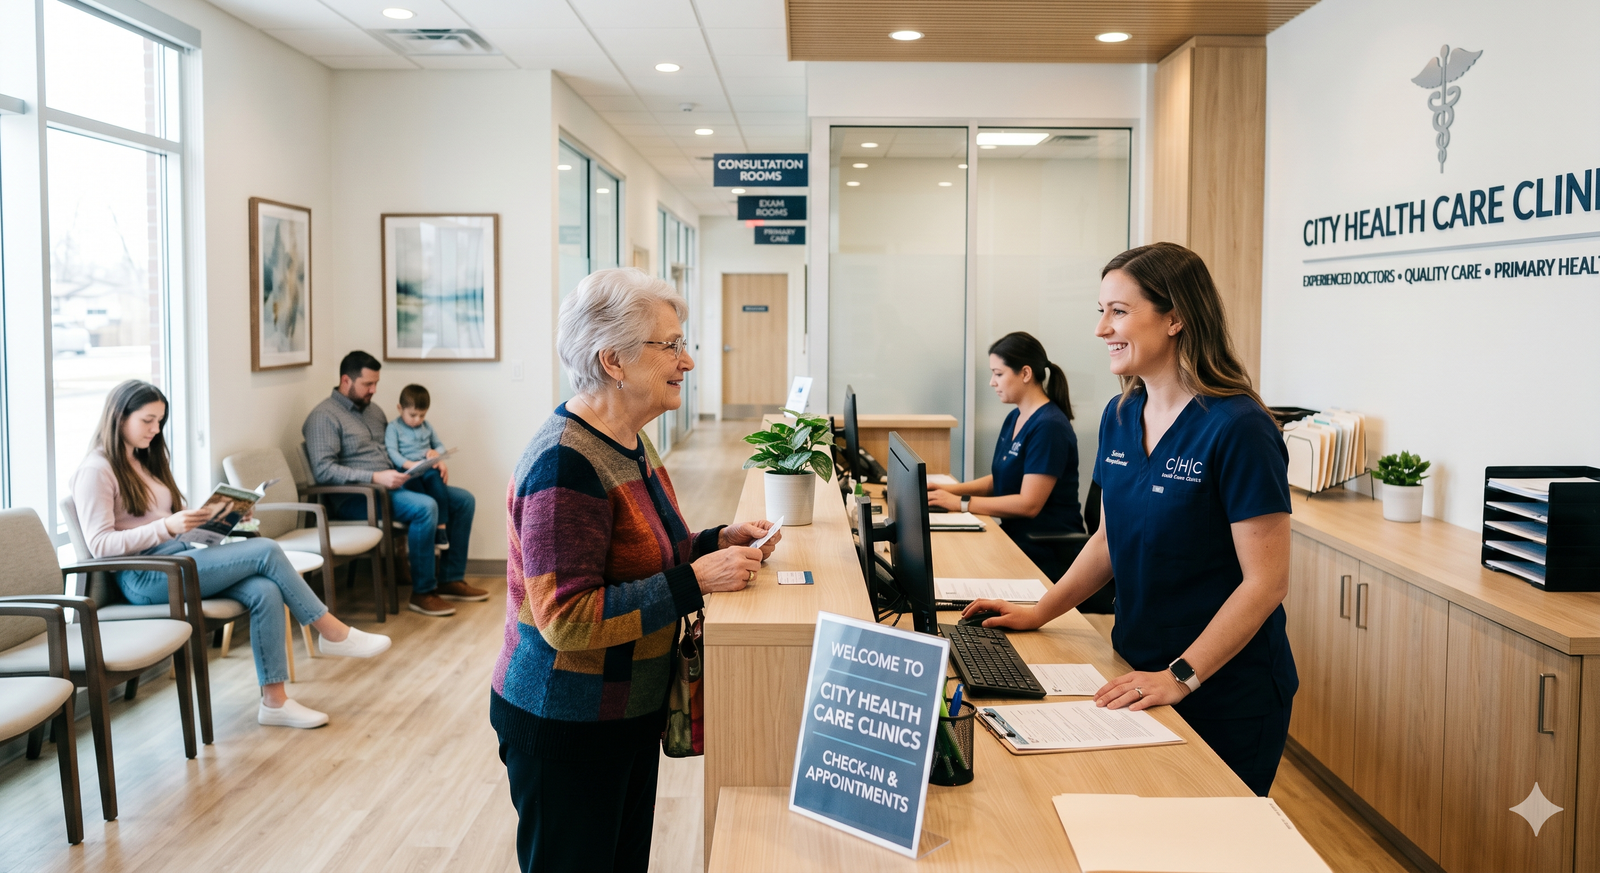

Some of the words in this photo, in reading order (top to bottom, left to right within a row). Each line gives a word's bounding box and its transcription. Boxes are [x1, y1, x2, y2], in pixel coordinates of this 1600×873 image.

[718, 160, 803, 170] CONSULTATION
[740, 171, 782, 181] ROOMS
[756, 208, 788, 216] ROOMS
[759, 200, 784, 208] EXAM
[1303, 214, 1340, 246] CITY
[1345, 200, 1425, 242] HEALTH
[1432, 186, 1504, 230] CARE
[1303, 272, 1352, 286] EXPERIENCED
[1354, 269, 1395, 284] DOCTORS
[1404, 266, 1450, 284] QUALITY
[1452, 264, 1482, 280] CARE
[1494, 258, 1556, 278] PRIMARY
[1558, 256, 1600, 276] HEAL
[832, 642, 900, 672] WELCOME
[904, 658, 924, 678] TO
[820, 682, 856, 706] CITY
[858, 692, 922, 725] HEALTH
[814, 704, 854, 730] CARE
[858, 716, 922, 750] CLINICS
[822, 750, 884, 783] CHECK-IN
[888, 770, 898, 788] &
[805, 766, 908, 813] APPOINTMENTS
